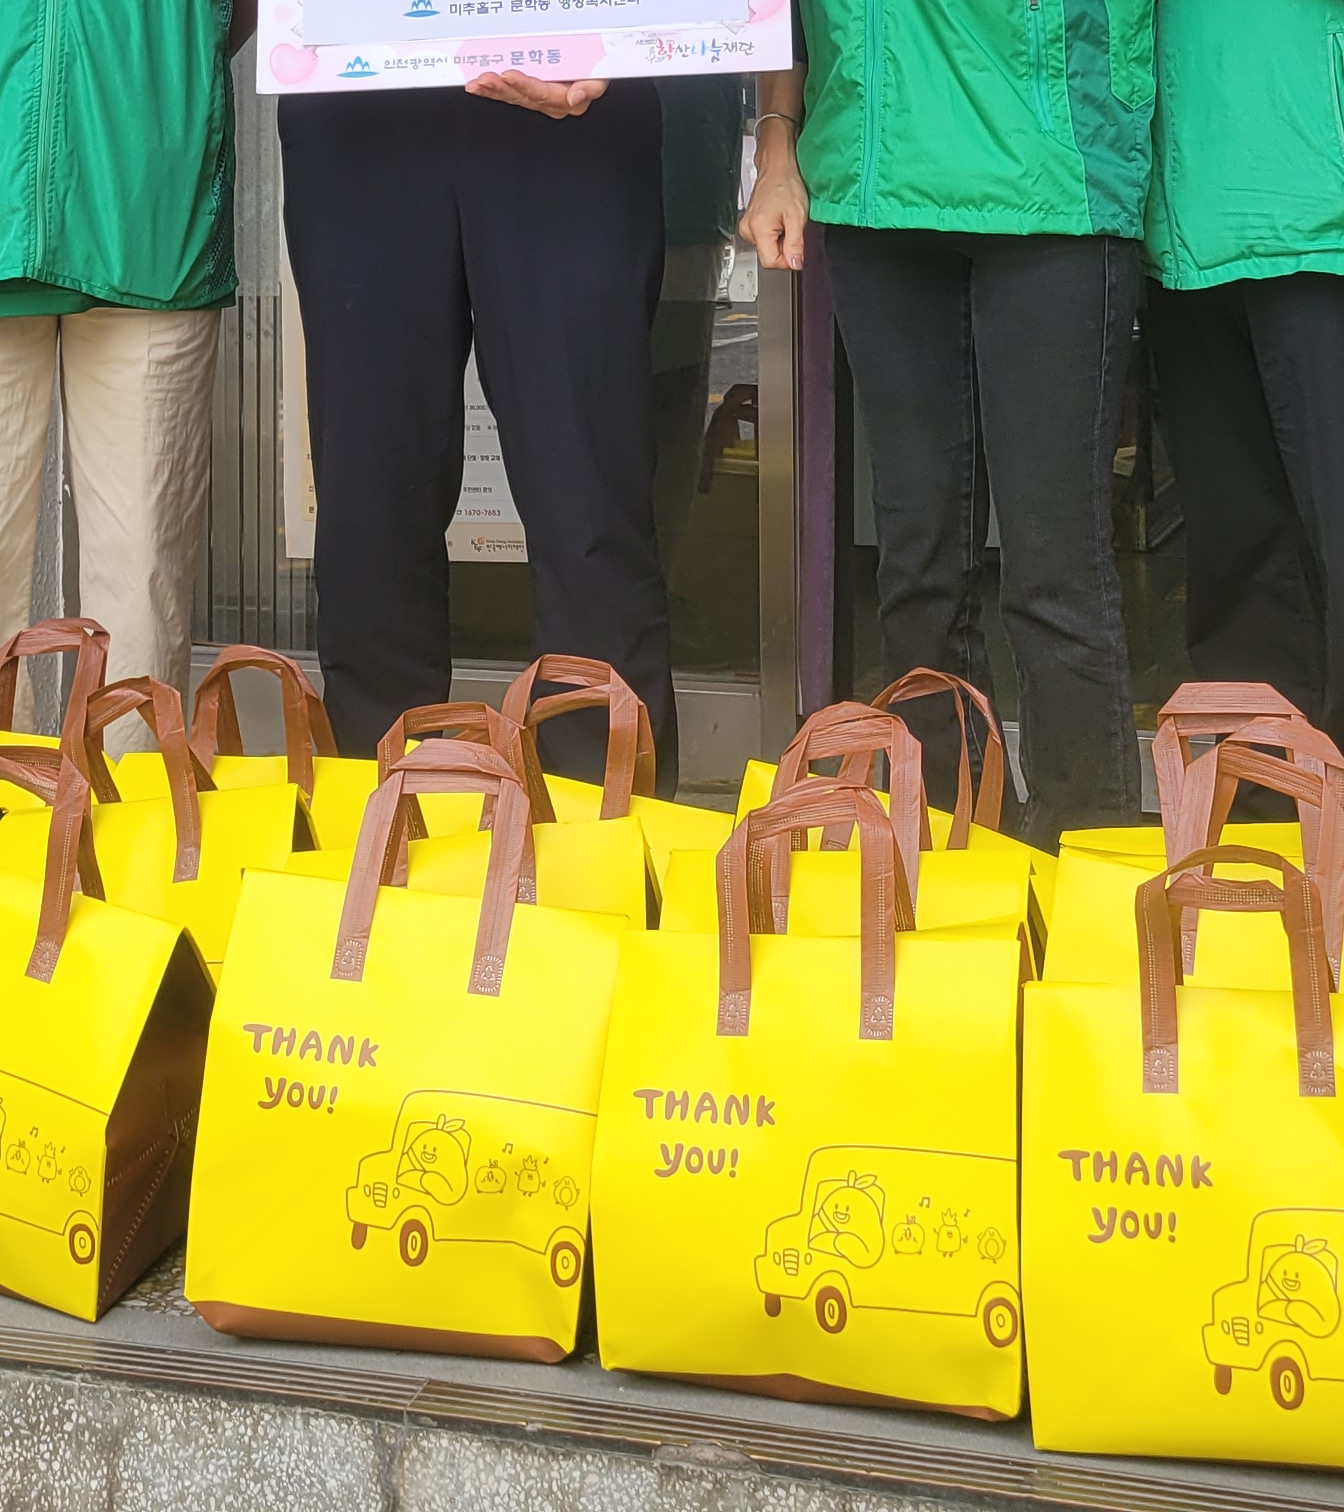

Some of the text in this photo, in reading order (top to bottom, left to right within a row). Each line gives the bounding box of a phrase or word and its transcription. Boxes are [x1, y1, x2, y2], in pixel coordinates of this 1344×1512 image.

[448, 0, 504, 17] 미추홀구
[384, 57, 448, 71] 인천광역시
[453, 54, 504, 67] 미추홀구
[242, 1022, 380, 1069] THANK
[632, 1088, 777, 1128] THANK
[1057, 1149, 1214, 1190] THANK
